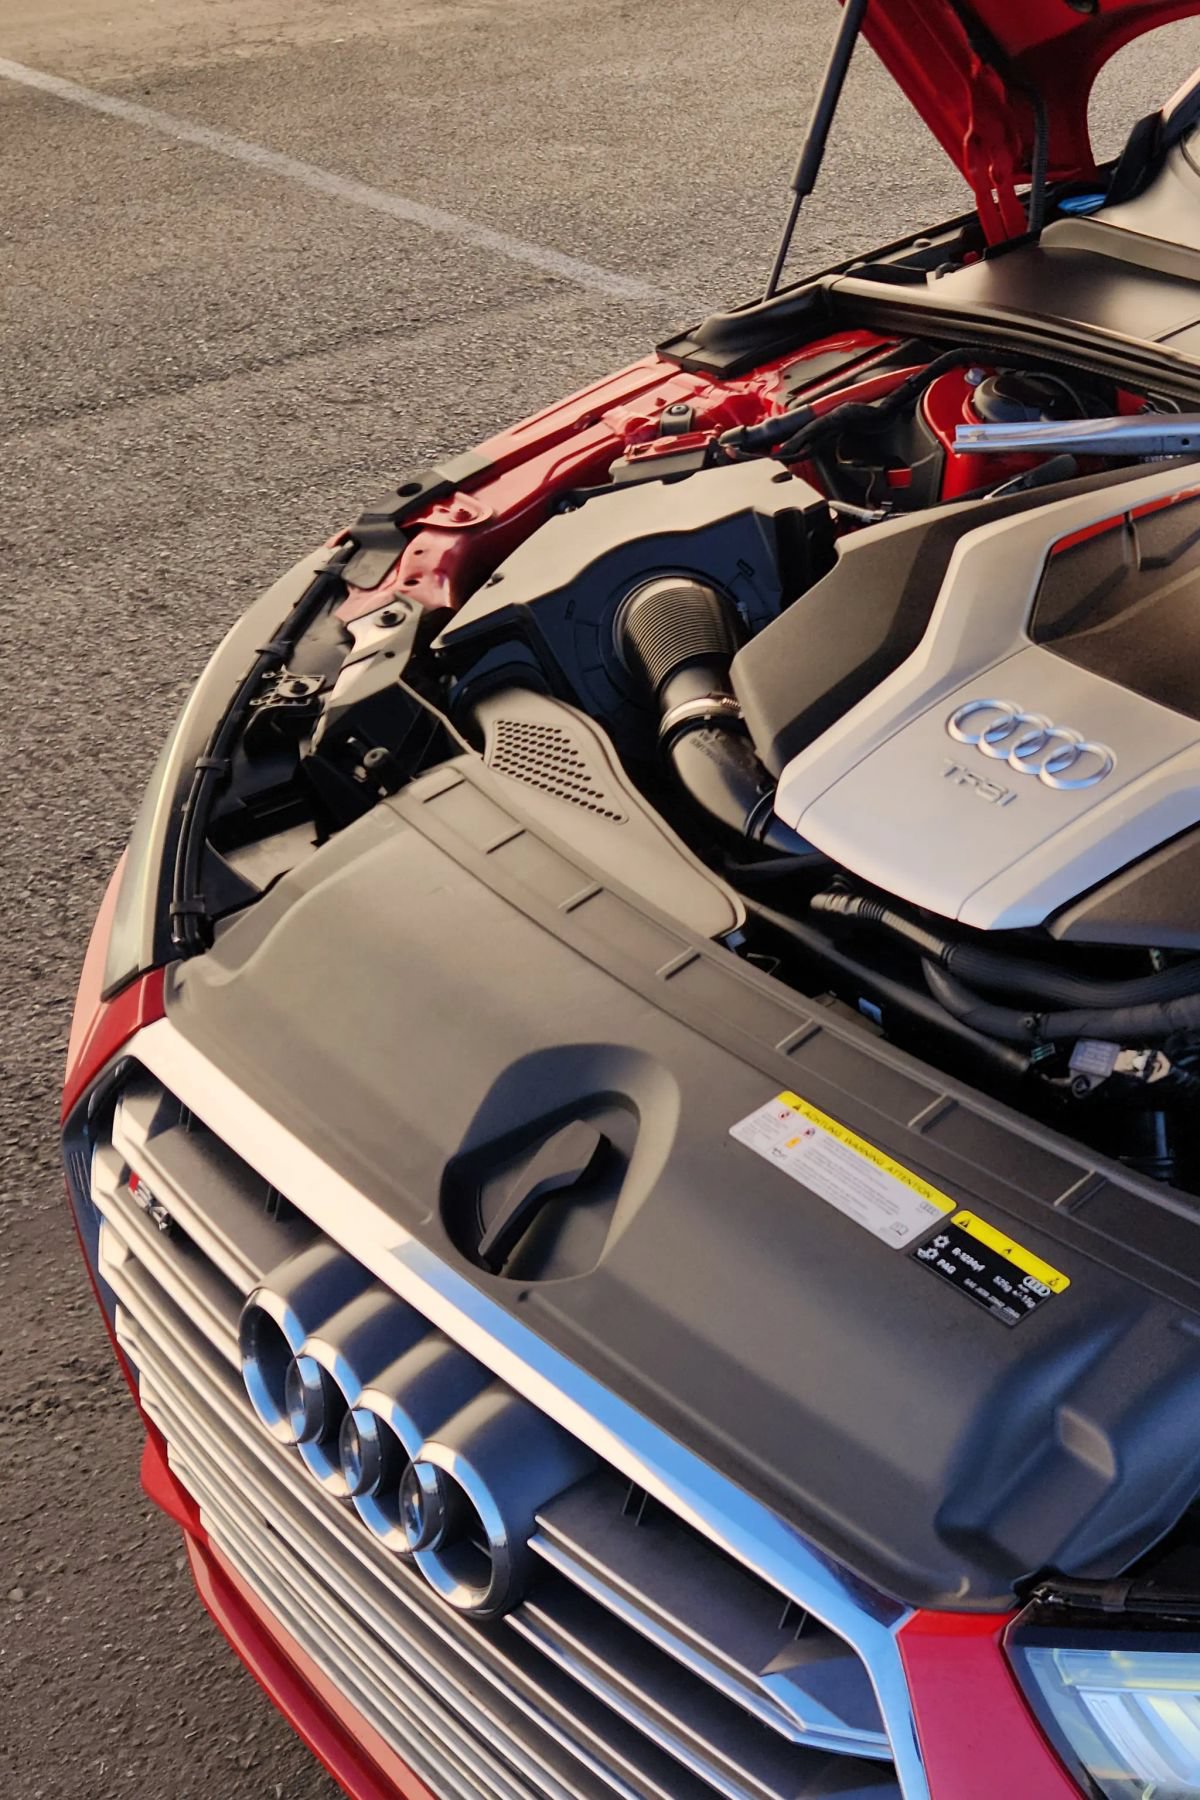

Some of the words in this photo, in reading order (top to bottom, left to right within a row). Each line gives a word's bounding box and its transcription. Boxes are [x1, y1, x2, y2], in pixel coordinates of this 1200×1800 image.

[941, 758, 1018, 807] TFSI
[803, 1109, 843, 1140] ACHTUNG
[843, 1135, 885, 1167] WARNING
[886, 1164, 933, 1198] ATTENTION
[132, 1178, 168, 1231] S4
[936, 1258, 957, 1275] PAG
